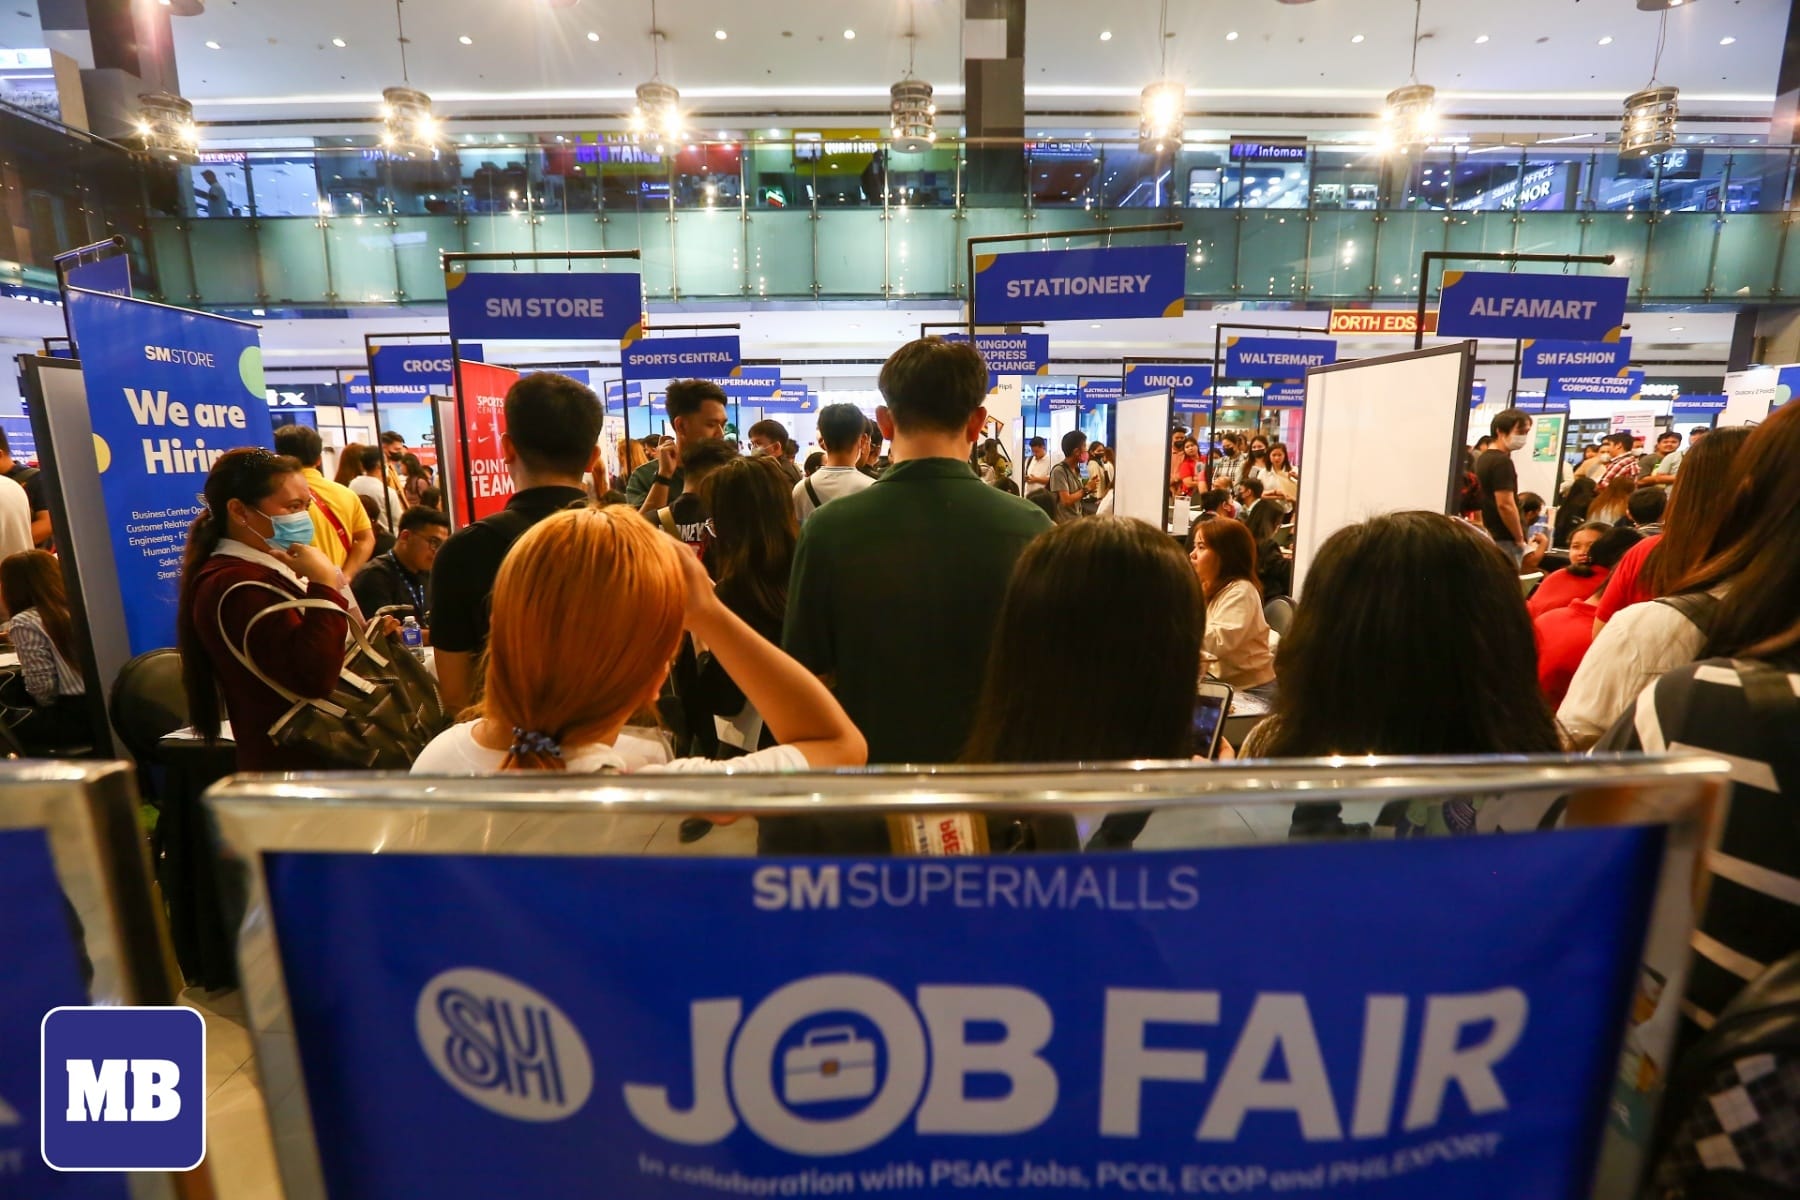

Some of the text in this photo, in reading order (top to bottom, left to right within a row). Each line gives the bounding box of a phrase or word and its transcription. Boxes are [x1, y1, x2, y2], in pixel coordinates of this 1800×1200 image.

[1007, 274, 1151, 298] STATIONERY
[486, 298, 604, 317] SM STORE
[1469, 297, 1597, 320] ALFAMART
[975, 340, 1026, 349] KINGDOM
[629, 352, 732, 365] SPORTS CENTRAL
[980, 351, 1027, 359] XPRESS
[1240, 352, 1324, 365] WALTERMART
[1537, 352, 1616, 365] SM FASHION
[985, 361, 1036, 370] XCHANGE
[1144, 376, 1193, 387] UNIQLO
[1602, 377, 1635, 386] CREDIT
[1562, 384, 1628, 394] CORPORATION
[476, 396, 504, 407] SPORTS
[123, 388, 246, 429] We are
[471, 474, 515, 498] TEAM
[132, 511, 166, 520] Business
[167, 508, 190, 518] Center
[126, 523, 163, 533] Customer
[129, 534, 174, 546] Engineering
[143, 547, 170, 556] Human
[157, 571, 176, 579] Store
[623, 973, 1528, 1156] JOB FAIR
[639, 1153, 666, 1177] In
[668, 1163, 854, 1198] collaboration
[861, 1161, 924, 1191] with
[931, 1160, 1011, 1189] PSAC
[1017, 1160, 1089, 1190] Jobs,
[1099, 1161, 1175, 1193] PCCI,
[1182, 1164, 1268, 1194] ECOP
[1270, 1166, 1324, 1191] and
